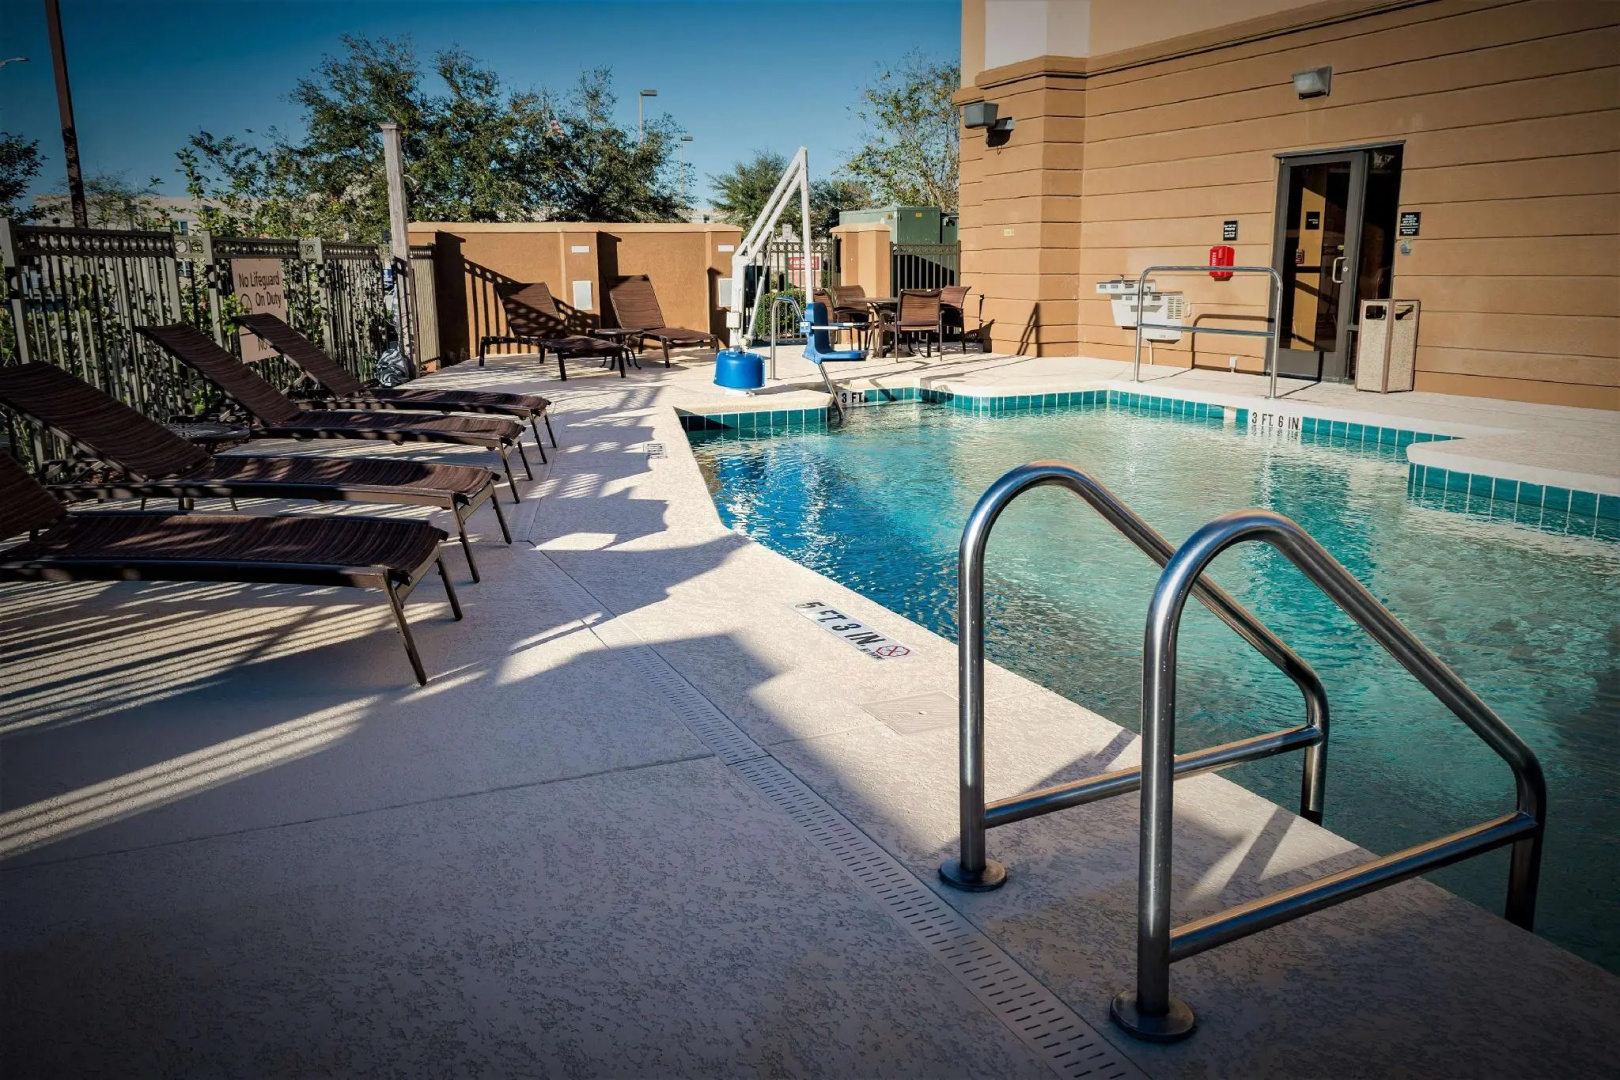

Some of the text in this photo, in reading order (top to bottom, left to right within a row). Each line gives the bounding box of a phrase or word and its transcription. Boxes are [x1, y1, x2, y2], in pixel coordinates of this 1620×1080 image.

[239, 272, 280, 290] No Lifeguard
[255, 292, 282, 308] On Duty
[841, 392, 847, 403] 3
[1251, 412, 1258, 424] 3
[1278, 415, 1284, 428] 6
[831, 623, 862, 631] 3
